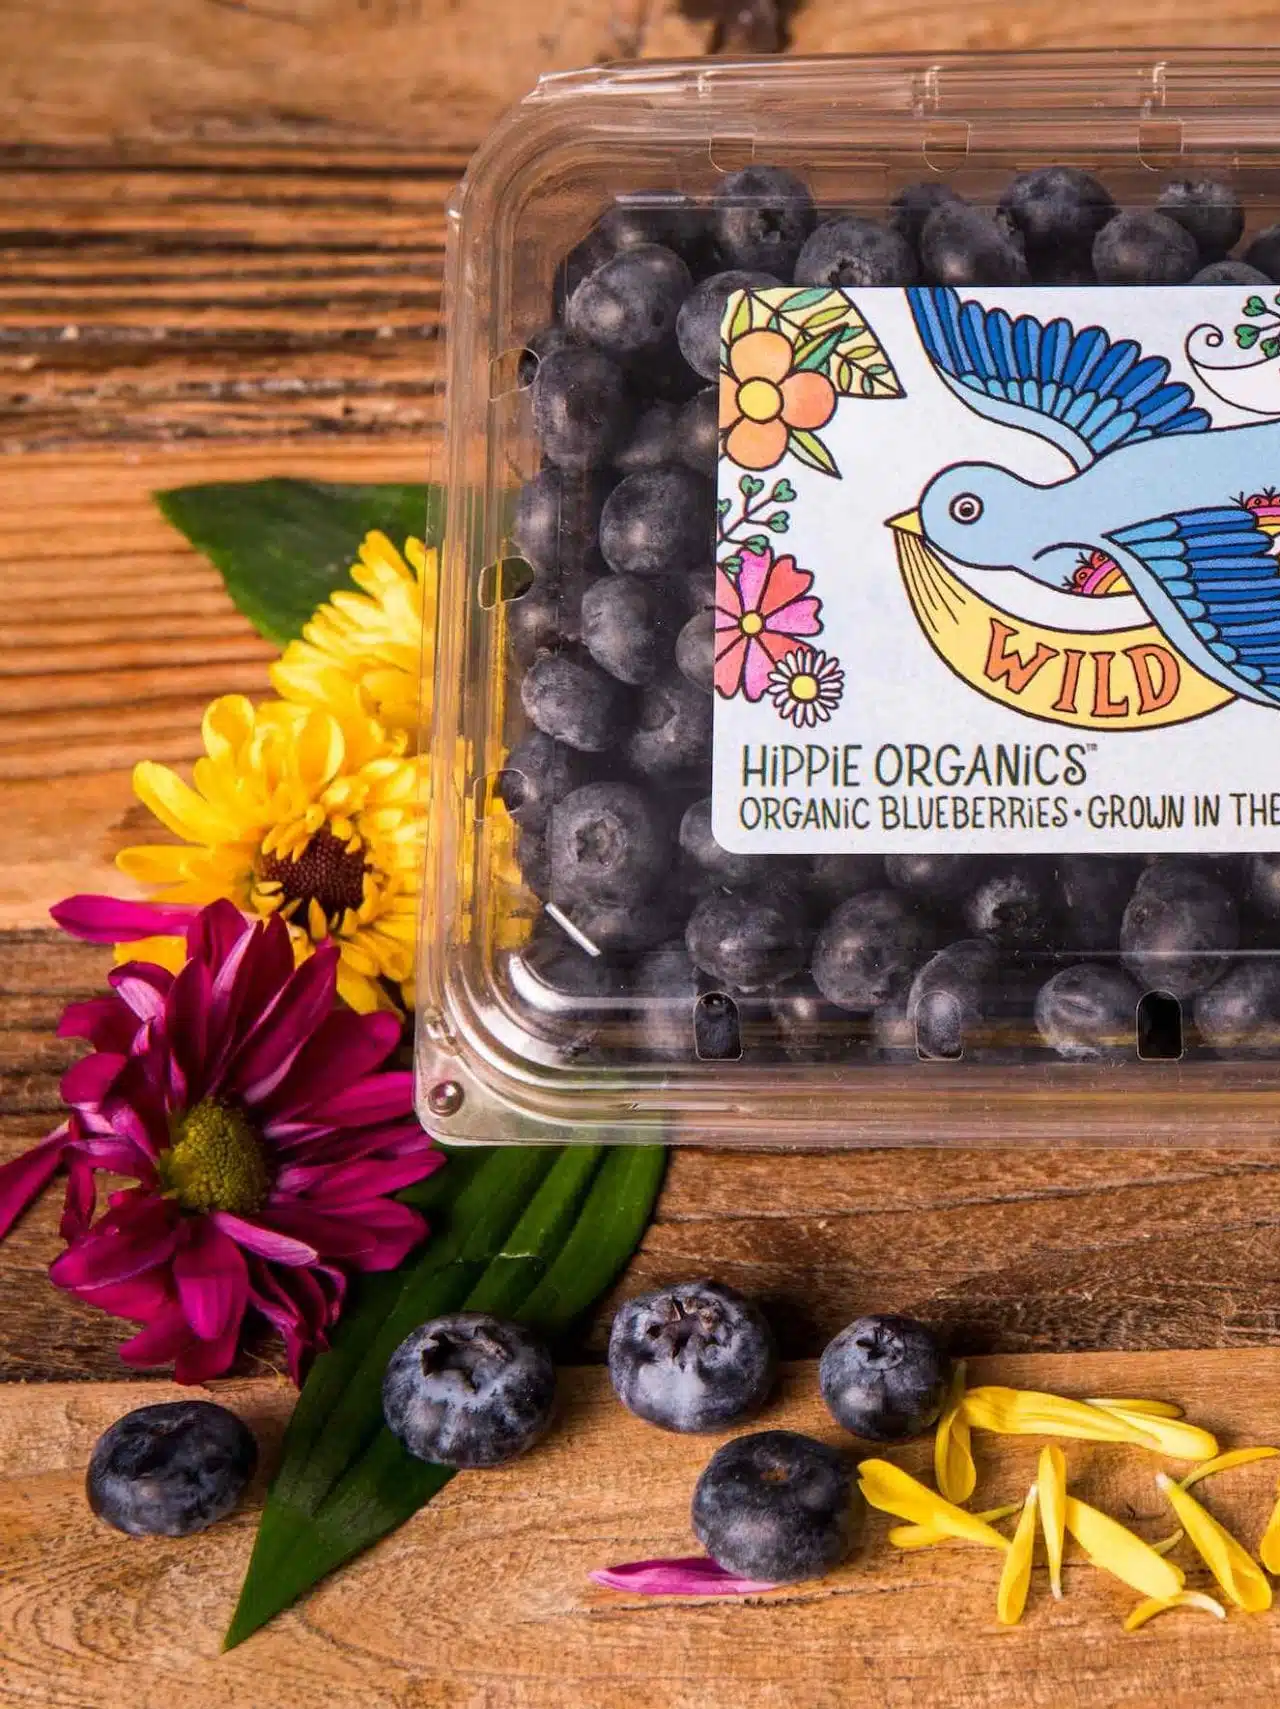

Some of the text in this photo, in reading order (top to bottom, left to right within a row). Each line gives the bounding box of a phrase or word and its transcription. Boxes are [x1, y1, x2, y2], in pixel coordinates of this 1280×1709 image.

[983, 617, 1181, 717] WILD
[1087, 795, 1184, 830] GROWN
[1194, 795, 1221, 827] IN
[1229, 792, 1280, 827] THE
